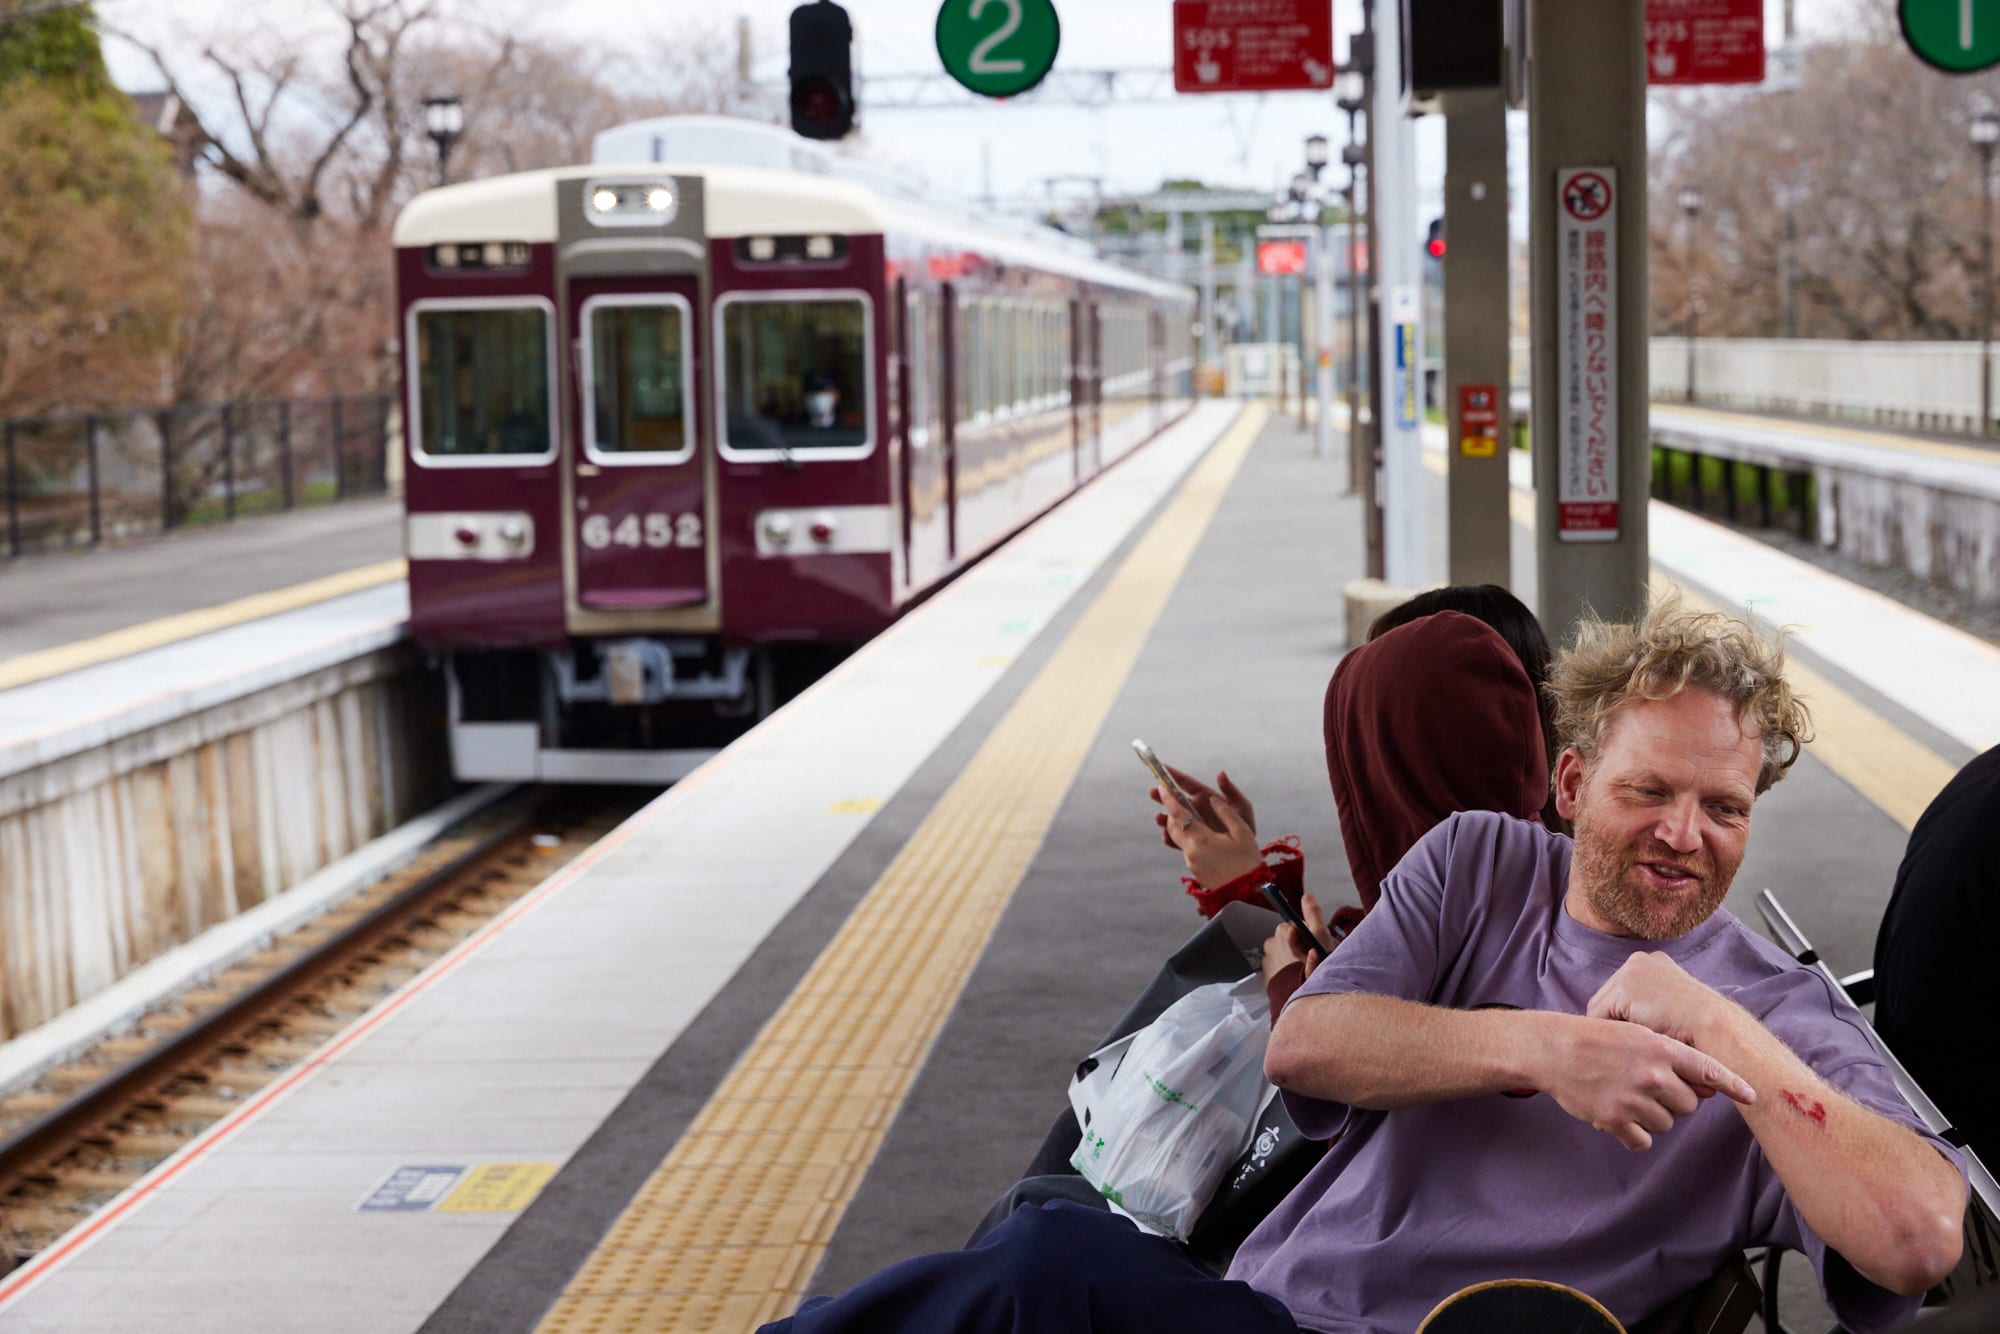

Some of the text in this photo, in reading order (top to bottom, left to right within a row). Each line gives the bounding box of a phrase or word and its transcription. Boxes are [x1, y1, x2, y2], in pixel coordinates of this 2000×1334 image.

[968, 0, 1026, 74] 2
[1184, 27, 1231, 50] SOS
[1584, 230, 1608, 496] 線路内へ降りないでください
[581, 513, 703, 549] 6452
